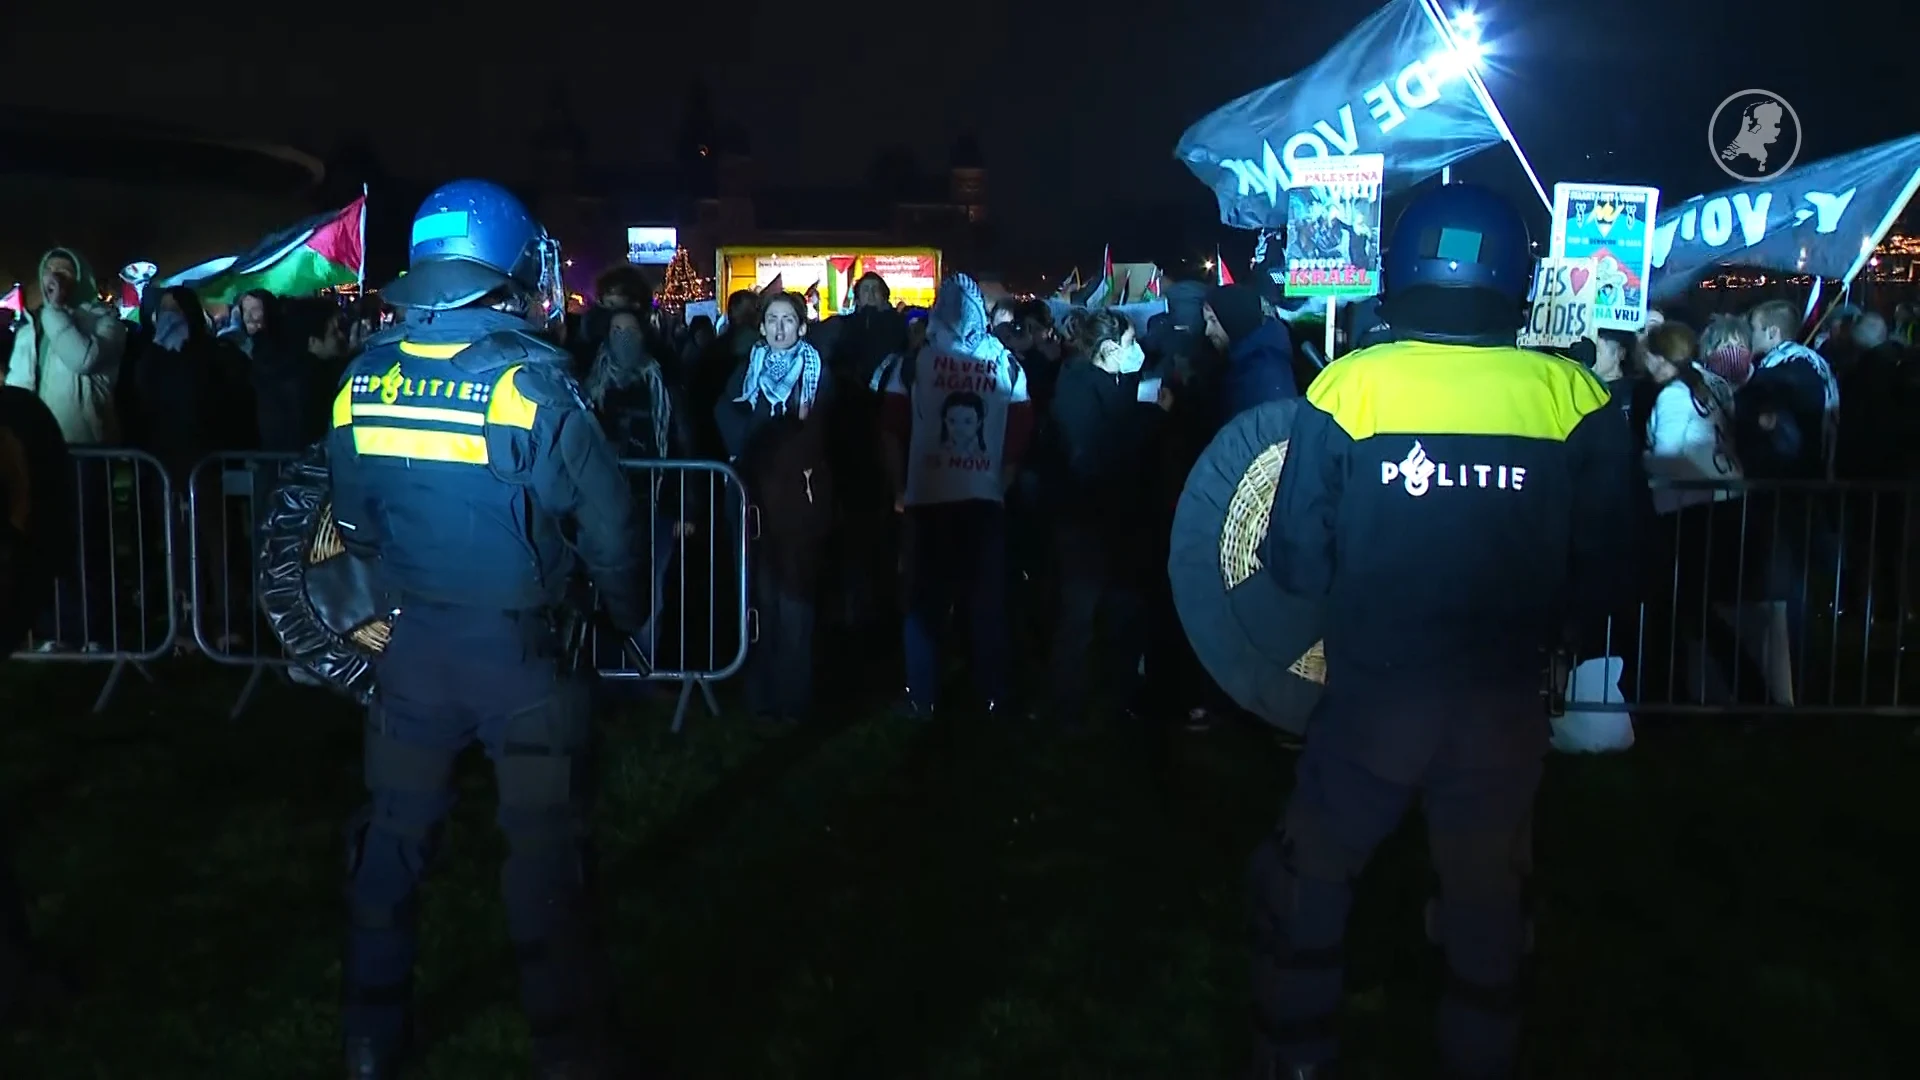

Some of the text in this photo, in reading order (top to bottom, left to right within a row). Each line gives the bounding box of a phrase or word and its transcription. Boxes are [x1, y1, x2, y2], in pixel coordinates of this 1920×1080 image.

[1304, 171, 1379, 182] PALESTINA
[1288, 257, 1346, 270] BOYCOT
[1614, 307, 1640, 322] VRIJ
[933, 355, 998, 375] NEVER
[368, 361, 475, 405] POLITIE
[933, 375, 998, 393] AGAIN
[948, 456, 991, 471] NOW
[1381, 439, 1528, 497] POLITIE
